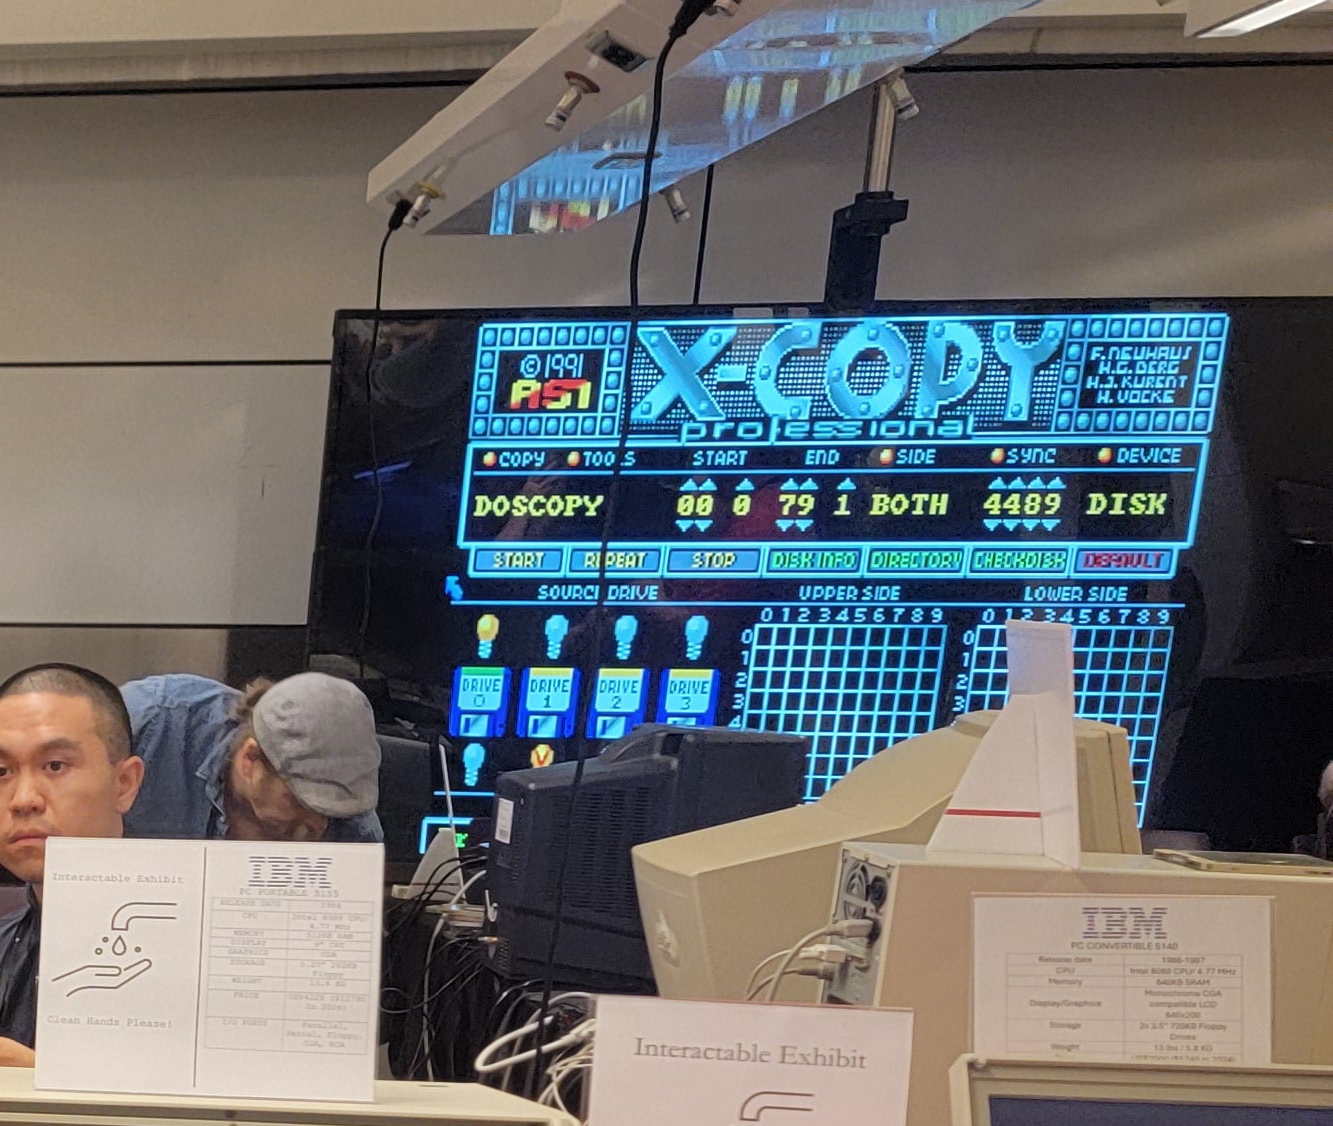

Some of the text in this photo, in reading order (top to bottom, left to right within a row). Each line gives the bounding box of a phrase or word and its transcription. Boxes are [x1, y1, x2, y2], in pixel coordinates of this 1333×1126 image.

[631, 320, 1067, 421] X-COPY
[679, 413, 976, 445] professional
[498, 447, 1182, 468] COPY TOOS START END SIDE SYNC DEVICE
[473, 491, 1168, 517] DOSCOPY 00 0 79 1 BOTH 4489 DISK
[493, 552, 545, 568] START
[692, 552, 737, 568] STOP
[772, 552, 858, 568] DISK INFO
[871, 552, 963, 568] DIRECTORY
[976, 553, 1066, 568] CHECKDISK
[1084, 553, 1164, 568] DEFAULT
[607, 585, 659, 600] DRIVE
[799, 585, 901, 600] UPPER SIDE
[1023, 586, 1129, 602] LOWER SIDE
[760, 607, 944, 622] 0 1 2 3 4 5 6 7 8 9
[982, 608, 995, 623] 0
[1043, 608, 1056, 623] 3
[1059, 608, 1074, 623] 4
[1078, 608, 1092, 624] 5
[1097, 608, 1110, 624] 6
[1118, 608, 1132, 624] 7
[1136, 608, 1151, 624] 8
[1157, 608, 1170, 624] 9
[741, 629, 753, 644] 0
[963, 630, 975, 645] 0
[741, 651, 749, 666] 1
[962, 652, 969, 667] 1
[462, 678, 500, 693] DRIVE
[530, 679, 570, 693] DRIVE
[599, 679, 639, 694] DRIVE
[669, 680, 709, 694] DRIVE
[735, 672, 748, 688] 2
[956, 674, 969, 690] 2
[473, 694, 485, 708] 0
[543, 695, 551, 709] 1
[611, 696, 622, 709] 2
[681, 697, 691, 710] 3
[732, 694, 745, 710] 3
[952, 696, 965, 712] 3
[52, 872, 184, 884] Interactable Exhibit
[248, 856, 333, 888] IBM
[239, 888, 251, 896] PC
[1082, 907, 1168, 939] IBM
[1071, 942, 1178, 950] PC CONVERTIBLE 5140
[47, 1015, 172, 1029] Clean Hands Please!
[633, 1036, 867, 1069] Interactable Exhibit
